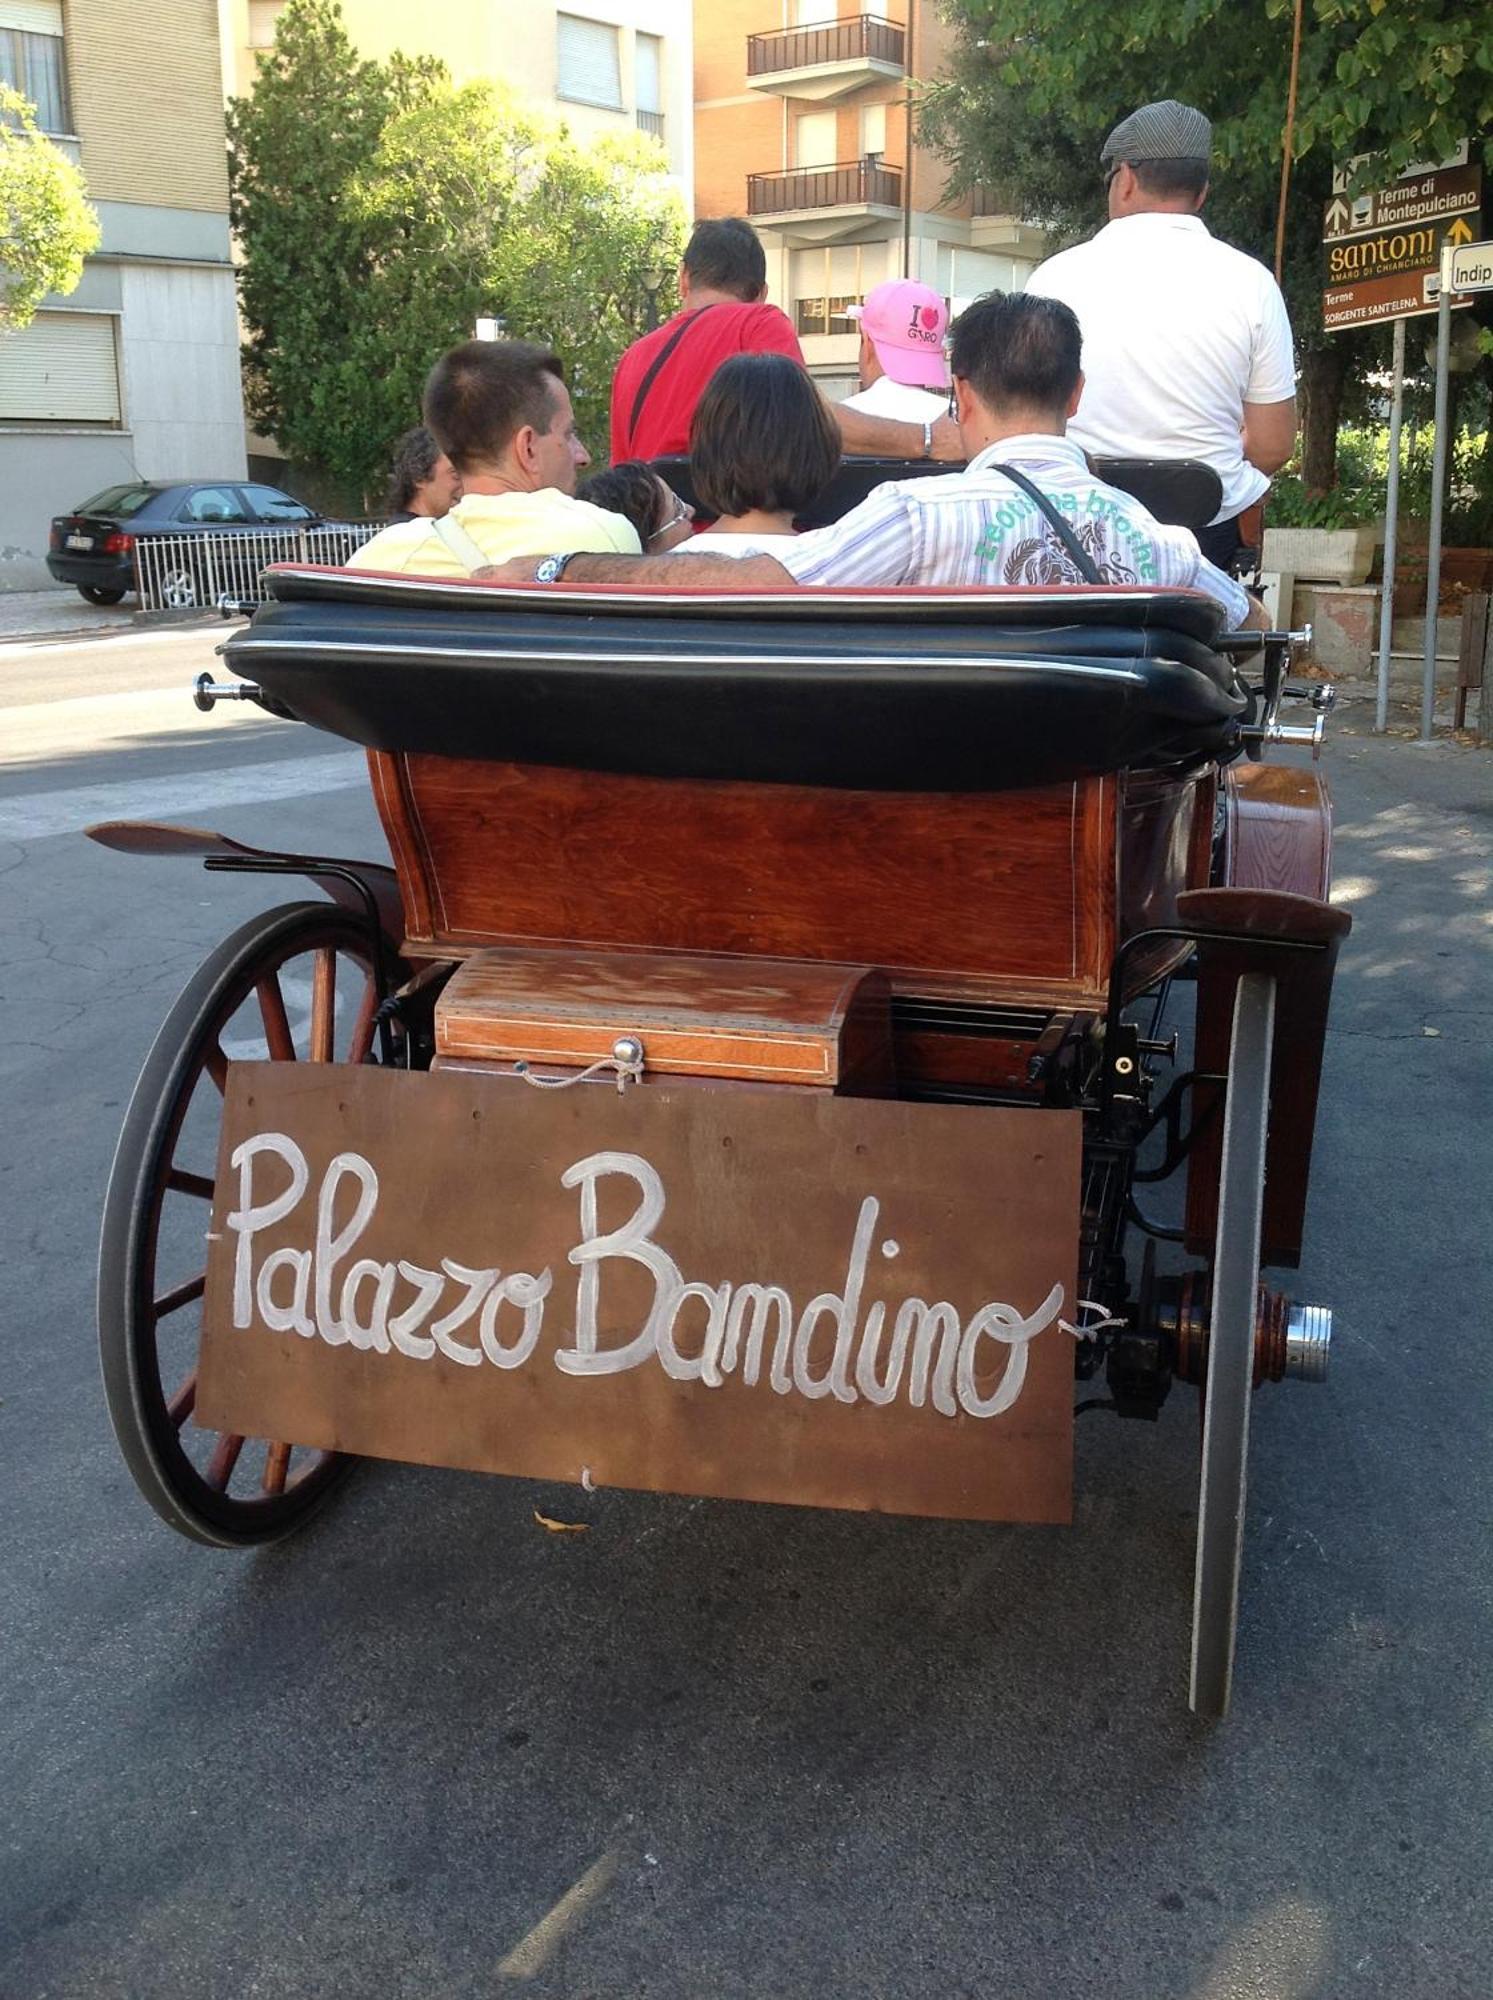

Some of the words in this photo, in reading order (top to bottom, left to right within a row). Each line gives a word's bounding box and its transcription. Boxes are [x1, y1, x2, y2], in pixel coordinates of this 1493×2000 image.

[1379, 186, 1418, 204] Terme
[1422, 179, 1434, 195] di
[1378, 192, 1476, 223] Montepulciano
[1331, 229, 1434, 271] santoni
[1330, 270, 1360, 281] AMARO
[1363, 267, 1373, 276] DI
[1376, 255, 1433, 273] CHIANCIANO
[1456, 264, 1493, 284] Indip
[1325, 292, 1353, 305] Terme
[1325, 307, 1366, 323] SORGENTE
[1368, 297, 1418, 315] SANT'ELENA
[909, 304, 922, 328] I
[226, 1130, 553, 1371] Palazzo
[554, 1150, 1066, 1419] Bandino
